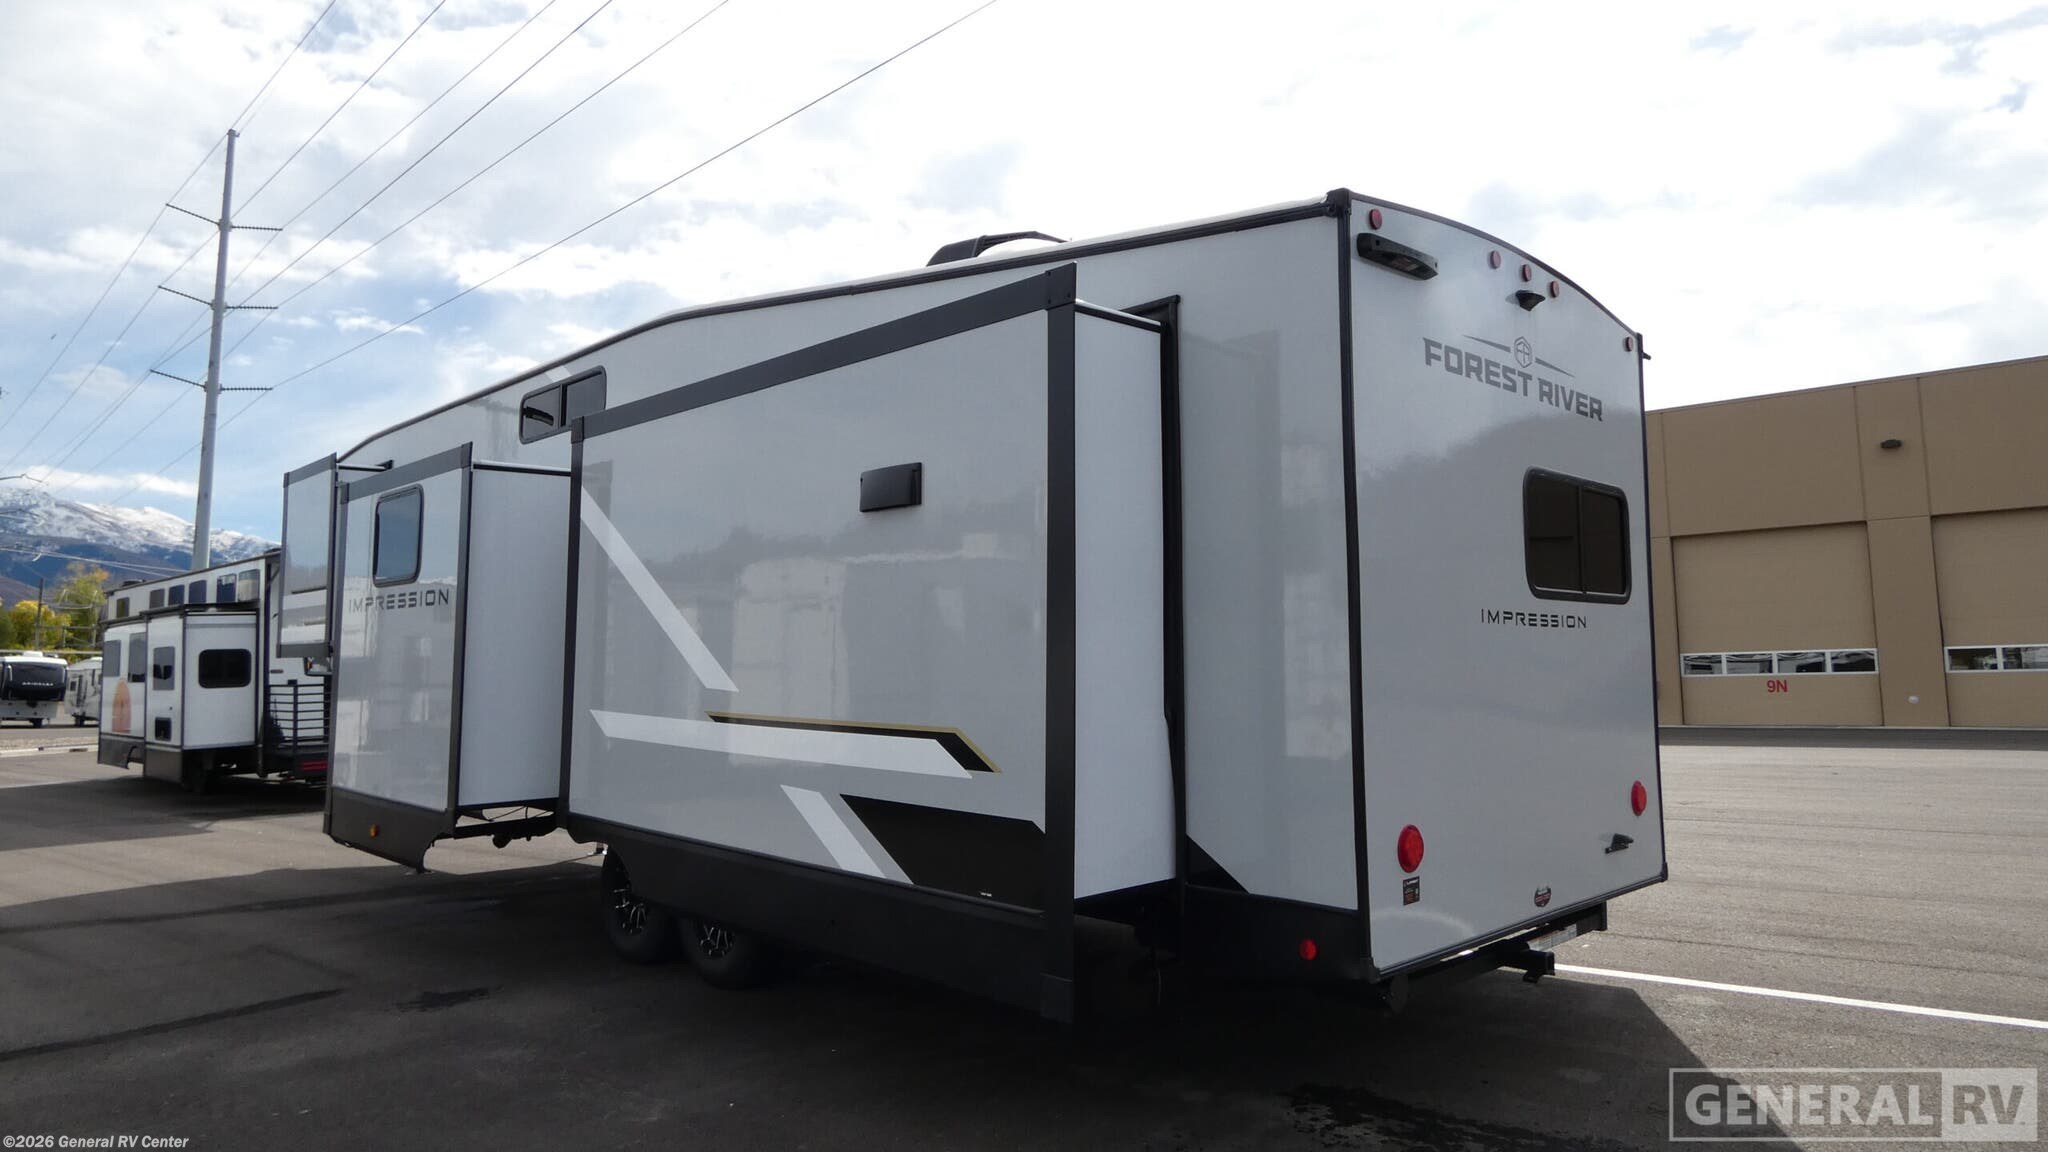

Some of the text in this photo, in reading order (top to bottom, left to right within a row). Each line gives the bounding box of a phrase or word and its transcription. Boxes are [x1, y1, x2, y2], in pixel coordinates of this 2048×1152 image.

[1423, 337, 1603, 422] FOREST RIVER
[348, 588, 450, 614] IMPRESSION
[1481, 608, 1587, 629] IMPRESSION
[1767, 679, 1788, 693] 9N
